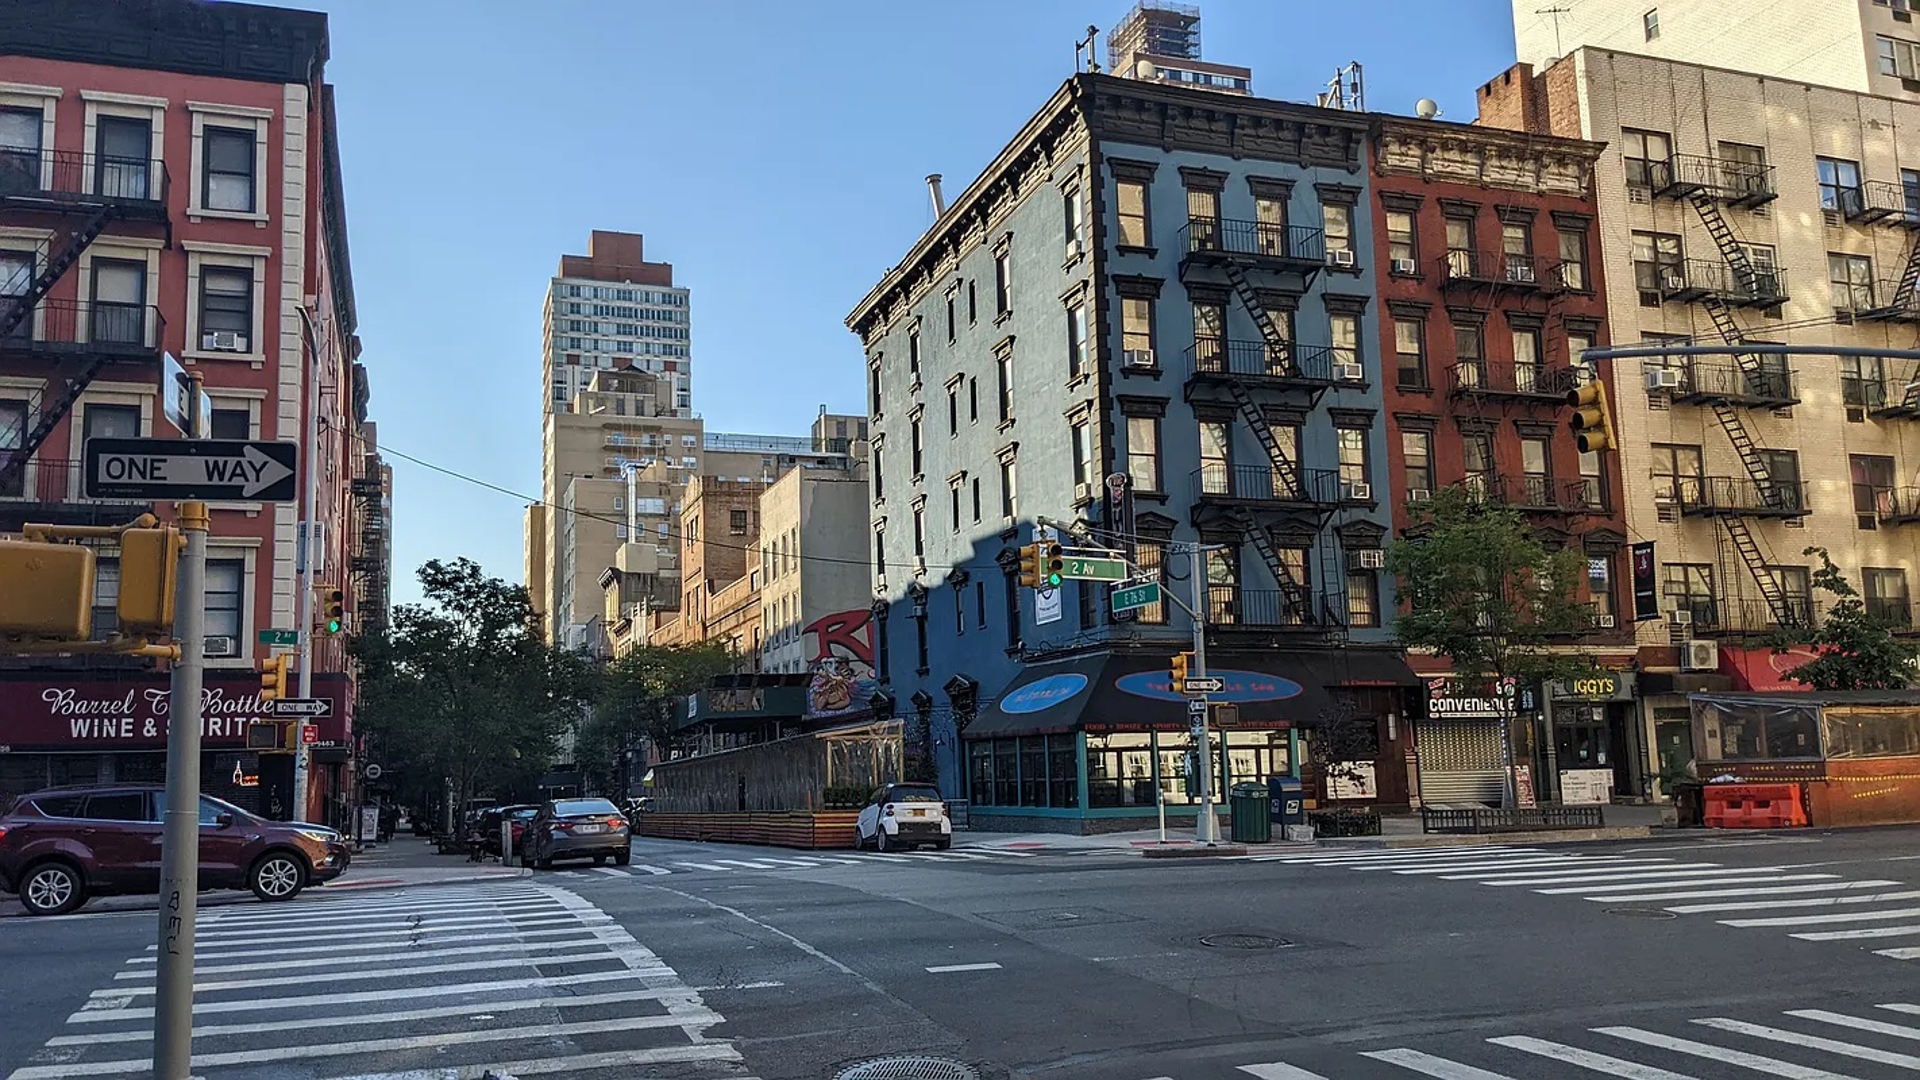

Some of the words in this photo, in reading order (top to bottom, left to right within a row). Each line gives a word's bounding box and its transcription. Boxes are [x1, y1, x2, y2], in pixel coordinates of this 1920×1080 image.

[106, 457, 167, 481] ONE
[204, 459, 269, 482] WAY
[1071, 562, 1079, 575] 2
[1082, 563, 1095, 574] Av
[1124, 592, 1130, 605] E
[274, 631, 281, 642] 2
[1574, 678, 1613, 695] IGGY'S
[42, 688, 137, 715] Barrel
[143, 688, 171, 715] T
[200, 688, 274, 714] Bottle
[281, 703, 298, 711] ONE
[306, 703, 324, 711] WAY
[143, 718, 157, 737] &
